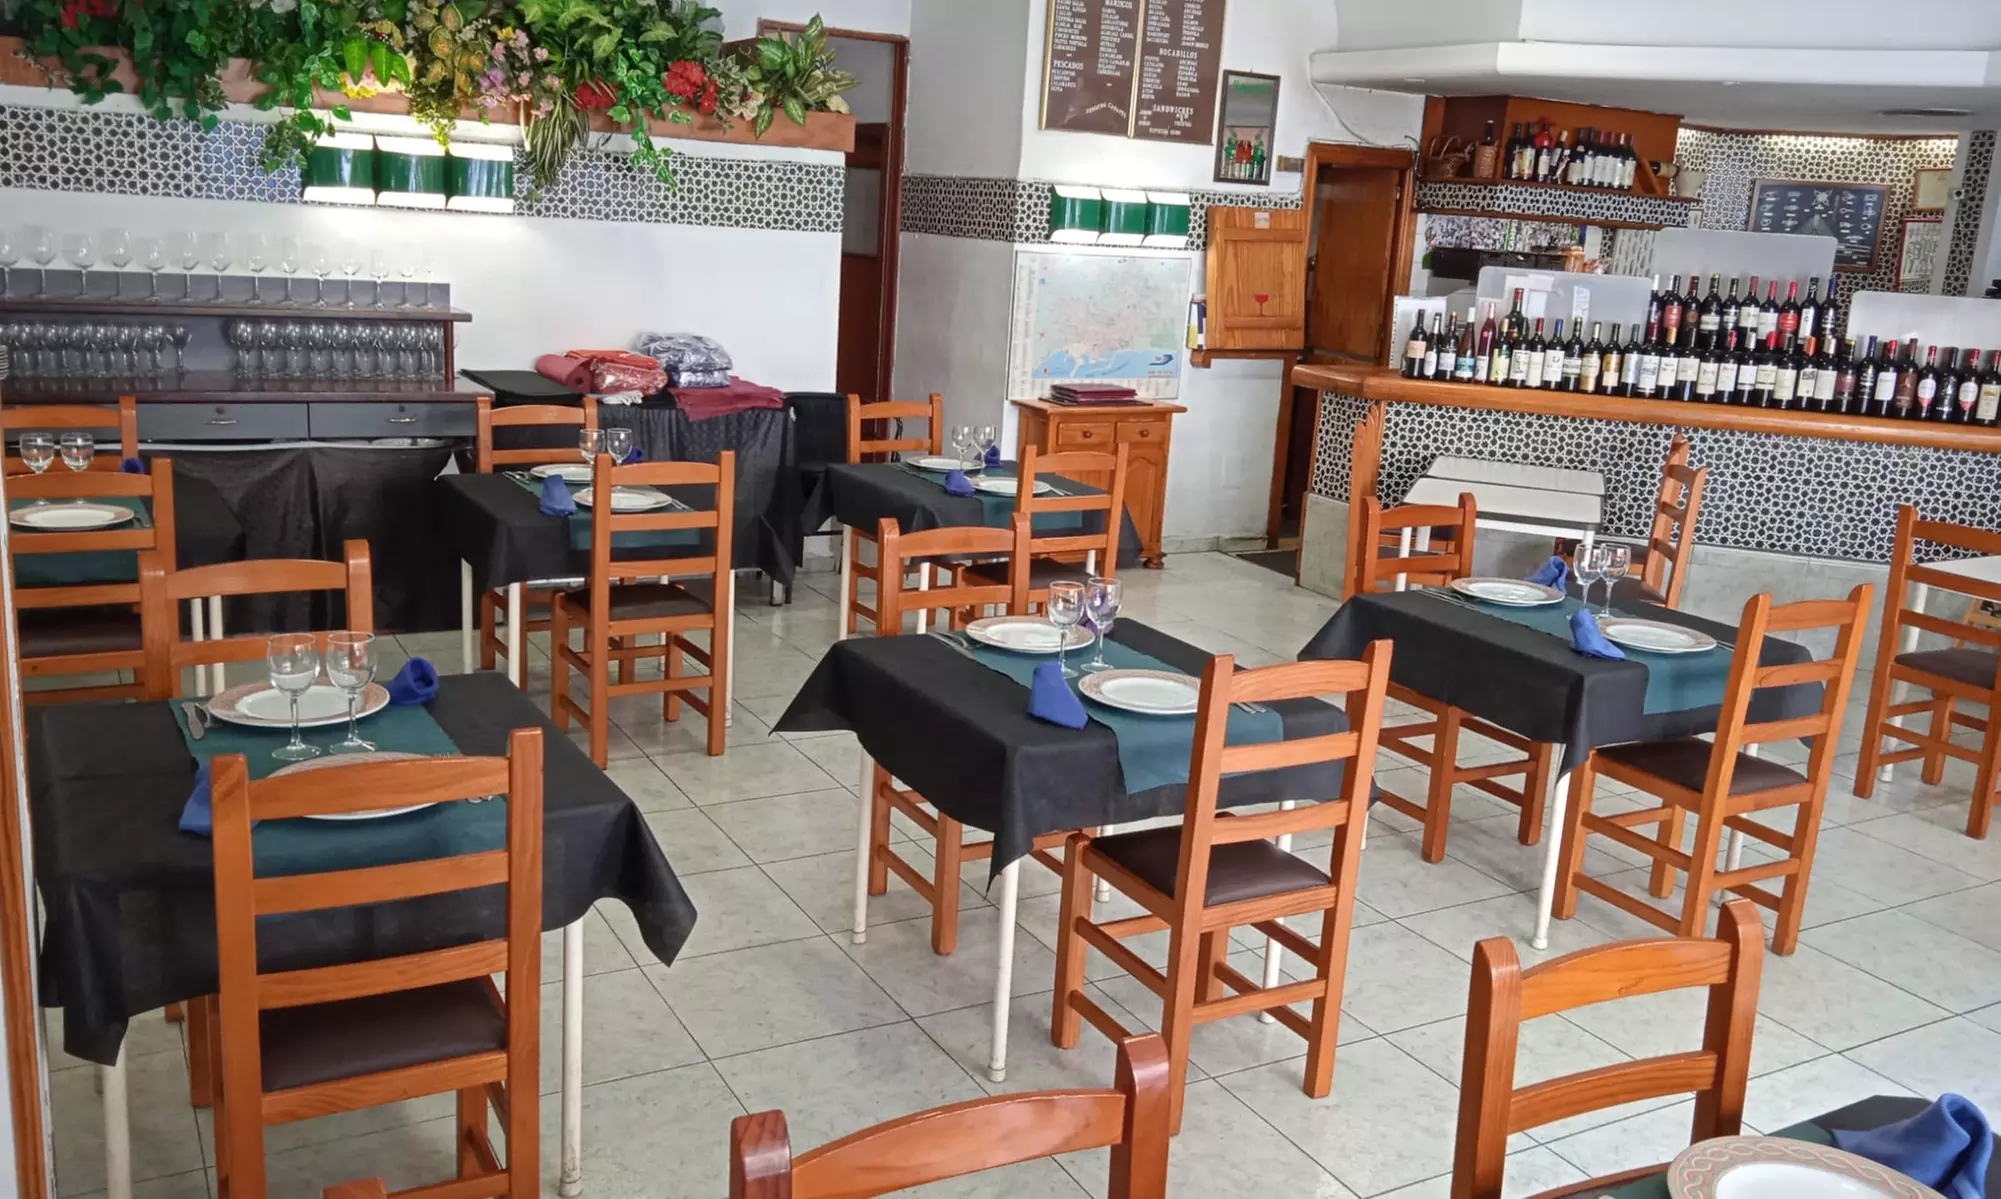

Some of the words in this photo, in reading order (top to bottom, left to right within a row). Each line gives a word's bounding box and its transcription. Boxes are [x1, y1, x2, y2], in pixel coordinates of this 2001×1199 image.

[1159, 48, 1197, 59] BOCADILLOS
[1053, 60, 1083, 70] PESCADOS
[1152, 104, 1194, 115] SANDWICHES
